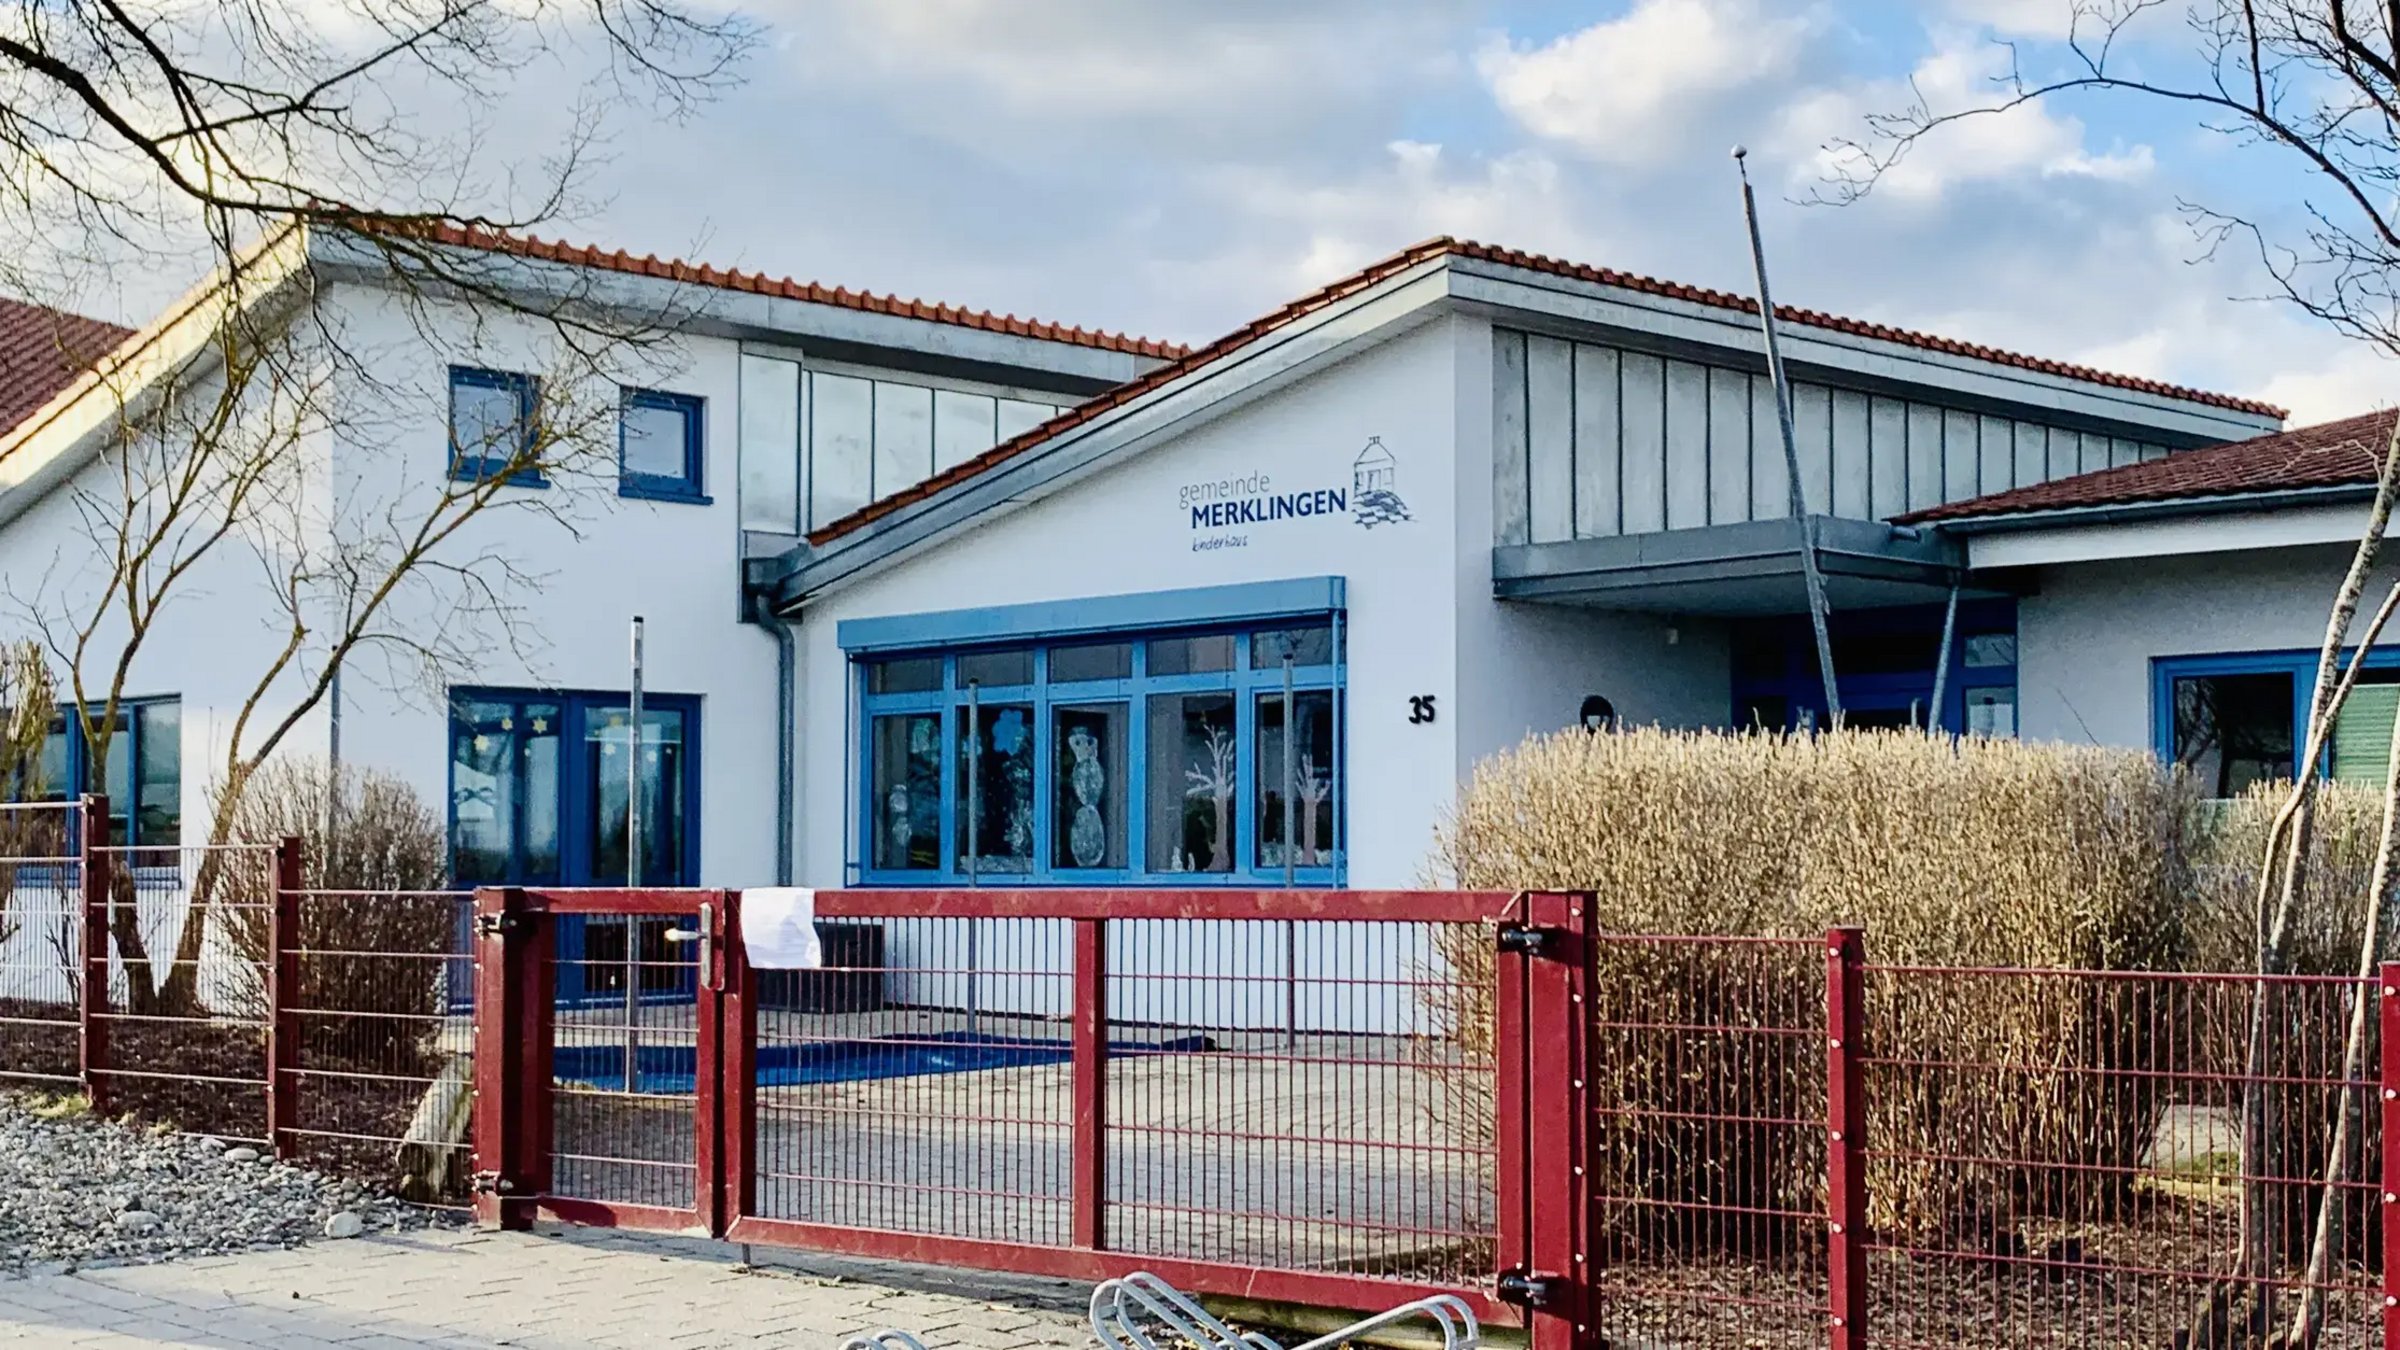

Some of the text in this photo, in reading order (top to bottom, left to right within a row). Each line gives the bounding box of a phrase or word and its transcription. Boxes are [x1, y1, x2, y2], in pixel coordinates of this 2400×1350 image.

[1179, 471, 1270, 508] gemeinde
[1192, 488, 1346, 529] MERKLINGEN
[1409, 695, 1435, 724] 35
